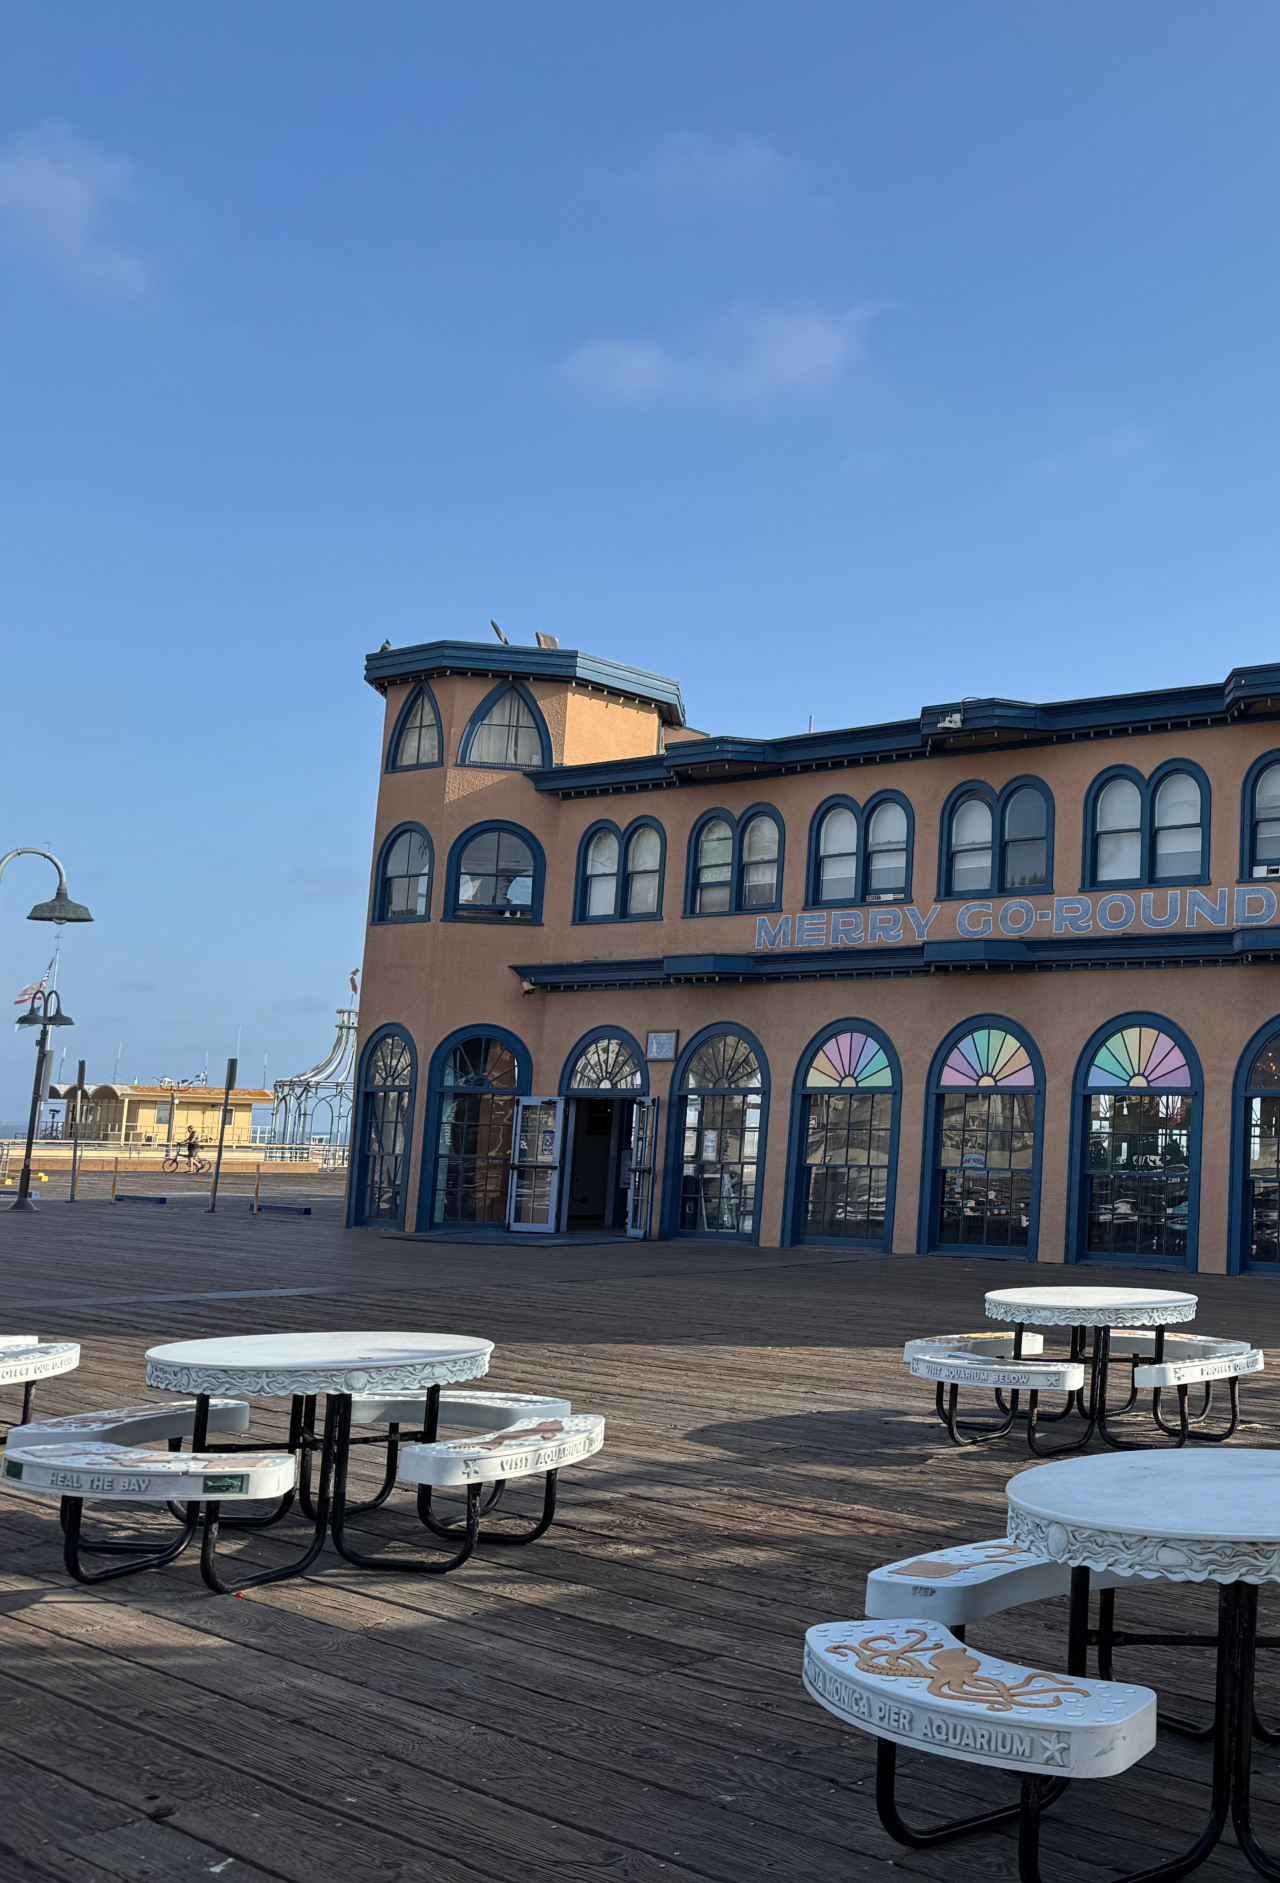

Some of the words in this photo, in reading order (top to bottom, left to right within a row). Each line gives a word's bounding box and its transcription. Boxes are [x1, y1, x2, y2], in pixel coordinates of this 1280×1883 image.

[755, 904, 940, 948] MERRY
[956, 886, 1278, 938] GO-ROUND
[944, 1368, 989, 1381] AQUARIUM
[993, 1373, 1030, 1385] BELOW
[500, 1455, 531, 1472] VISIT
[50, 1472, 82, 1488] HEAL
[87, 1475, 113, 1491] THE
[121, 1477, 150, 1492] BAY
[826, 1676, 872, 1718] MONICA
[878, 1703, 912, 1731] PIER
[923, 1716, 1033, 1758] AQUARIUM
